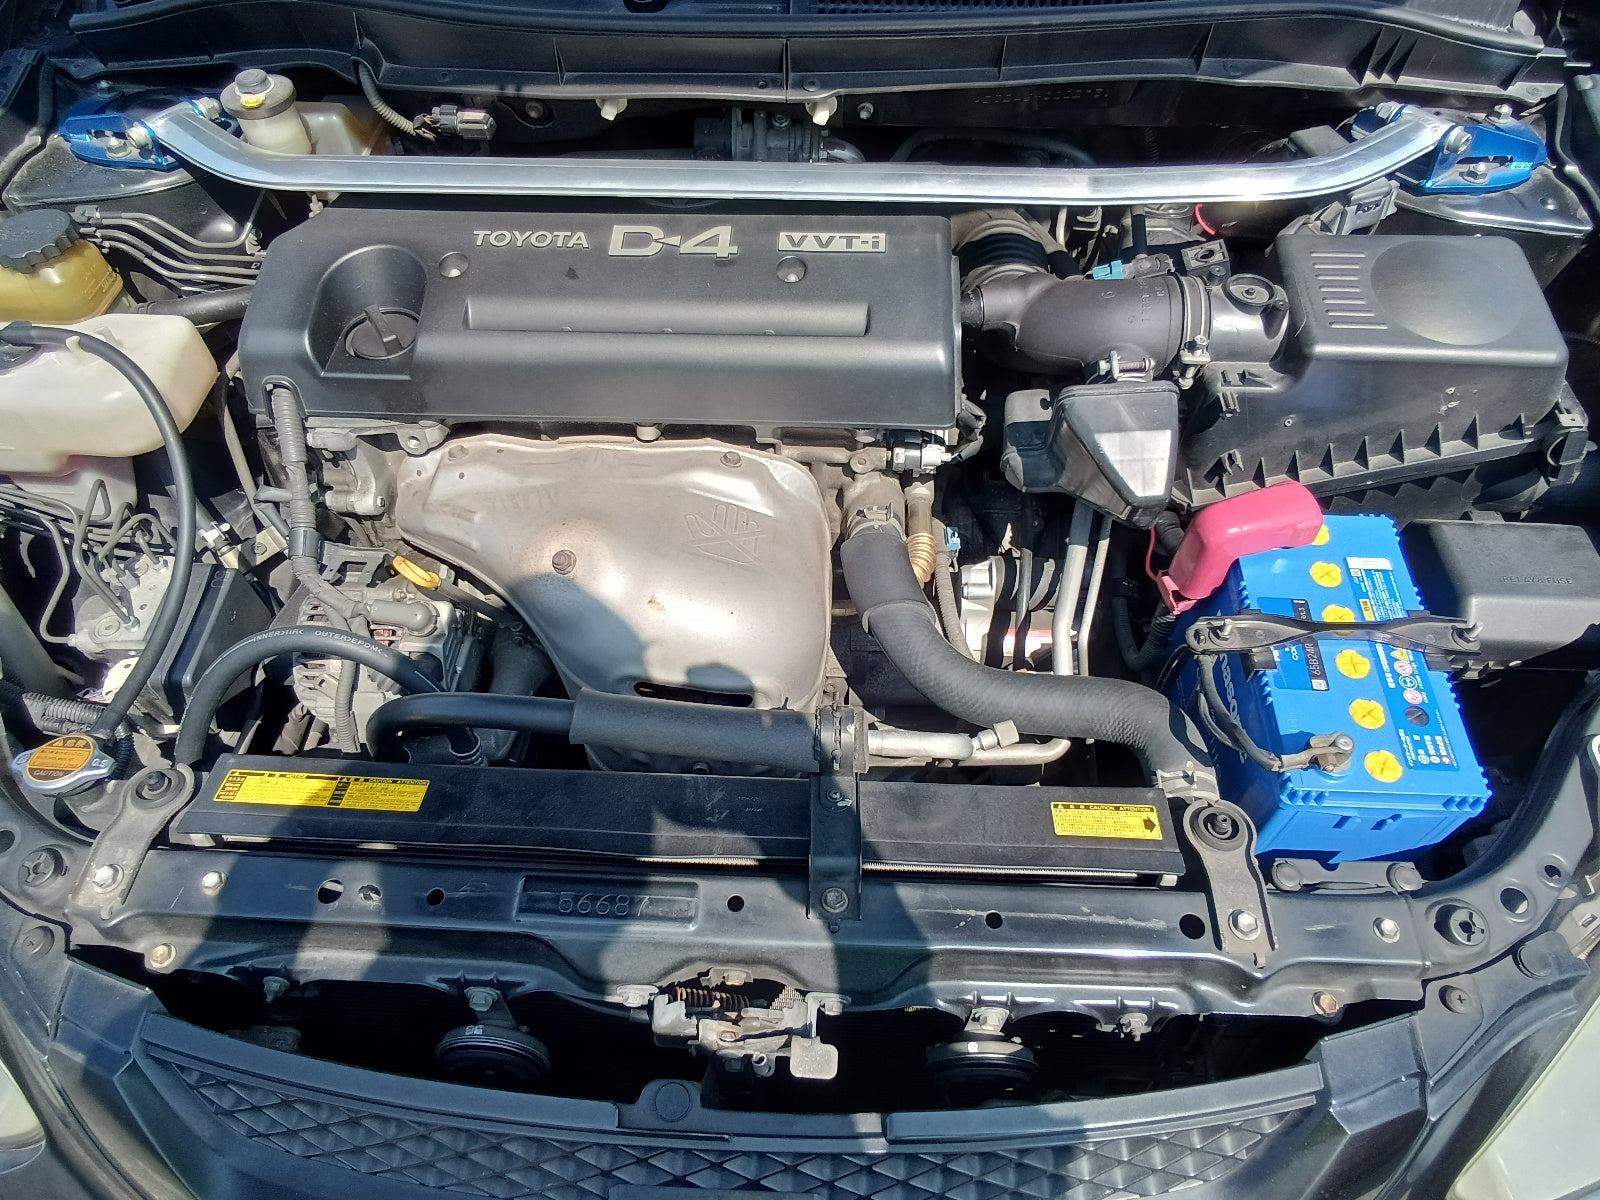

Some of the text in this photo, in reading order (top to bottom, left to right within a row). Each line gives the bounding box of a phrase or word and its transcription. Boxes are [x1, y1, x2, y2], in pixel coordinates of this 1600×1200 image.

[473, 229, 590, 249] TOYOTA
[782, 233, 882, 250] VVT-i
[1304, 643, 1322, 676] 65B24R
[33, 769, 66, 777] CAUTION
